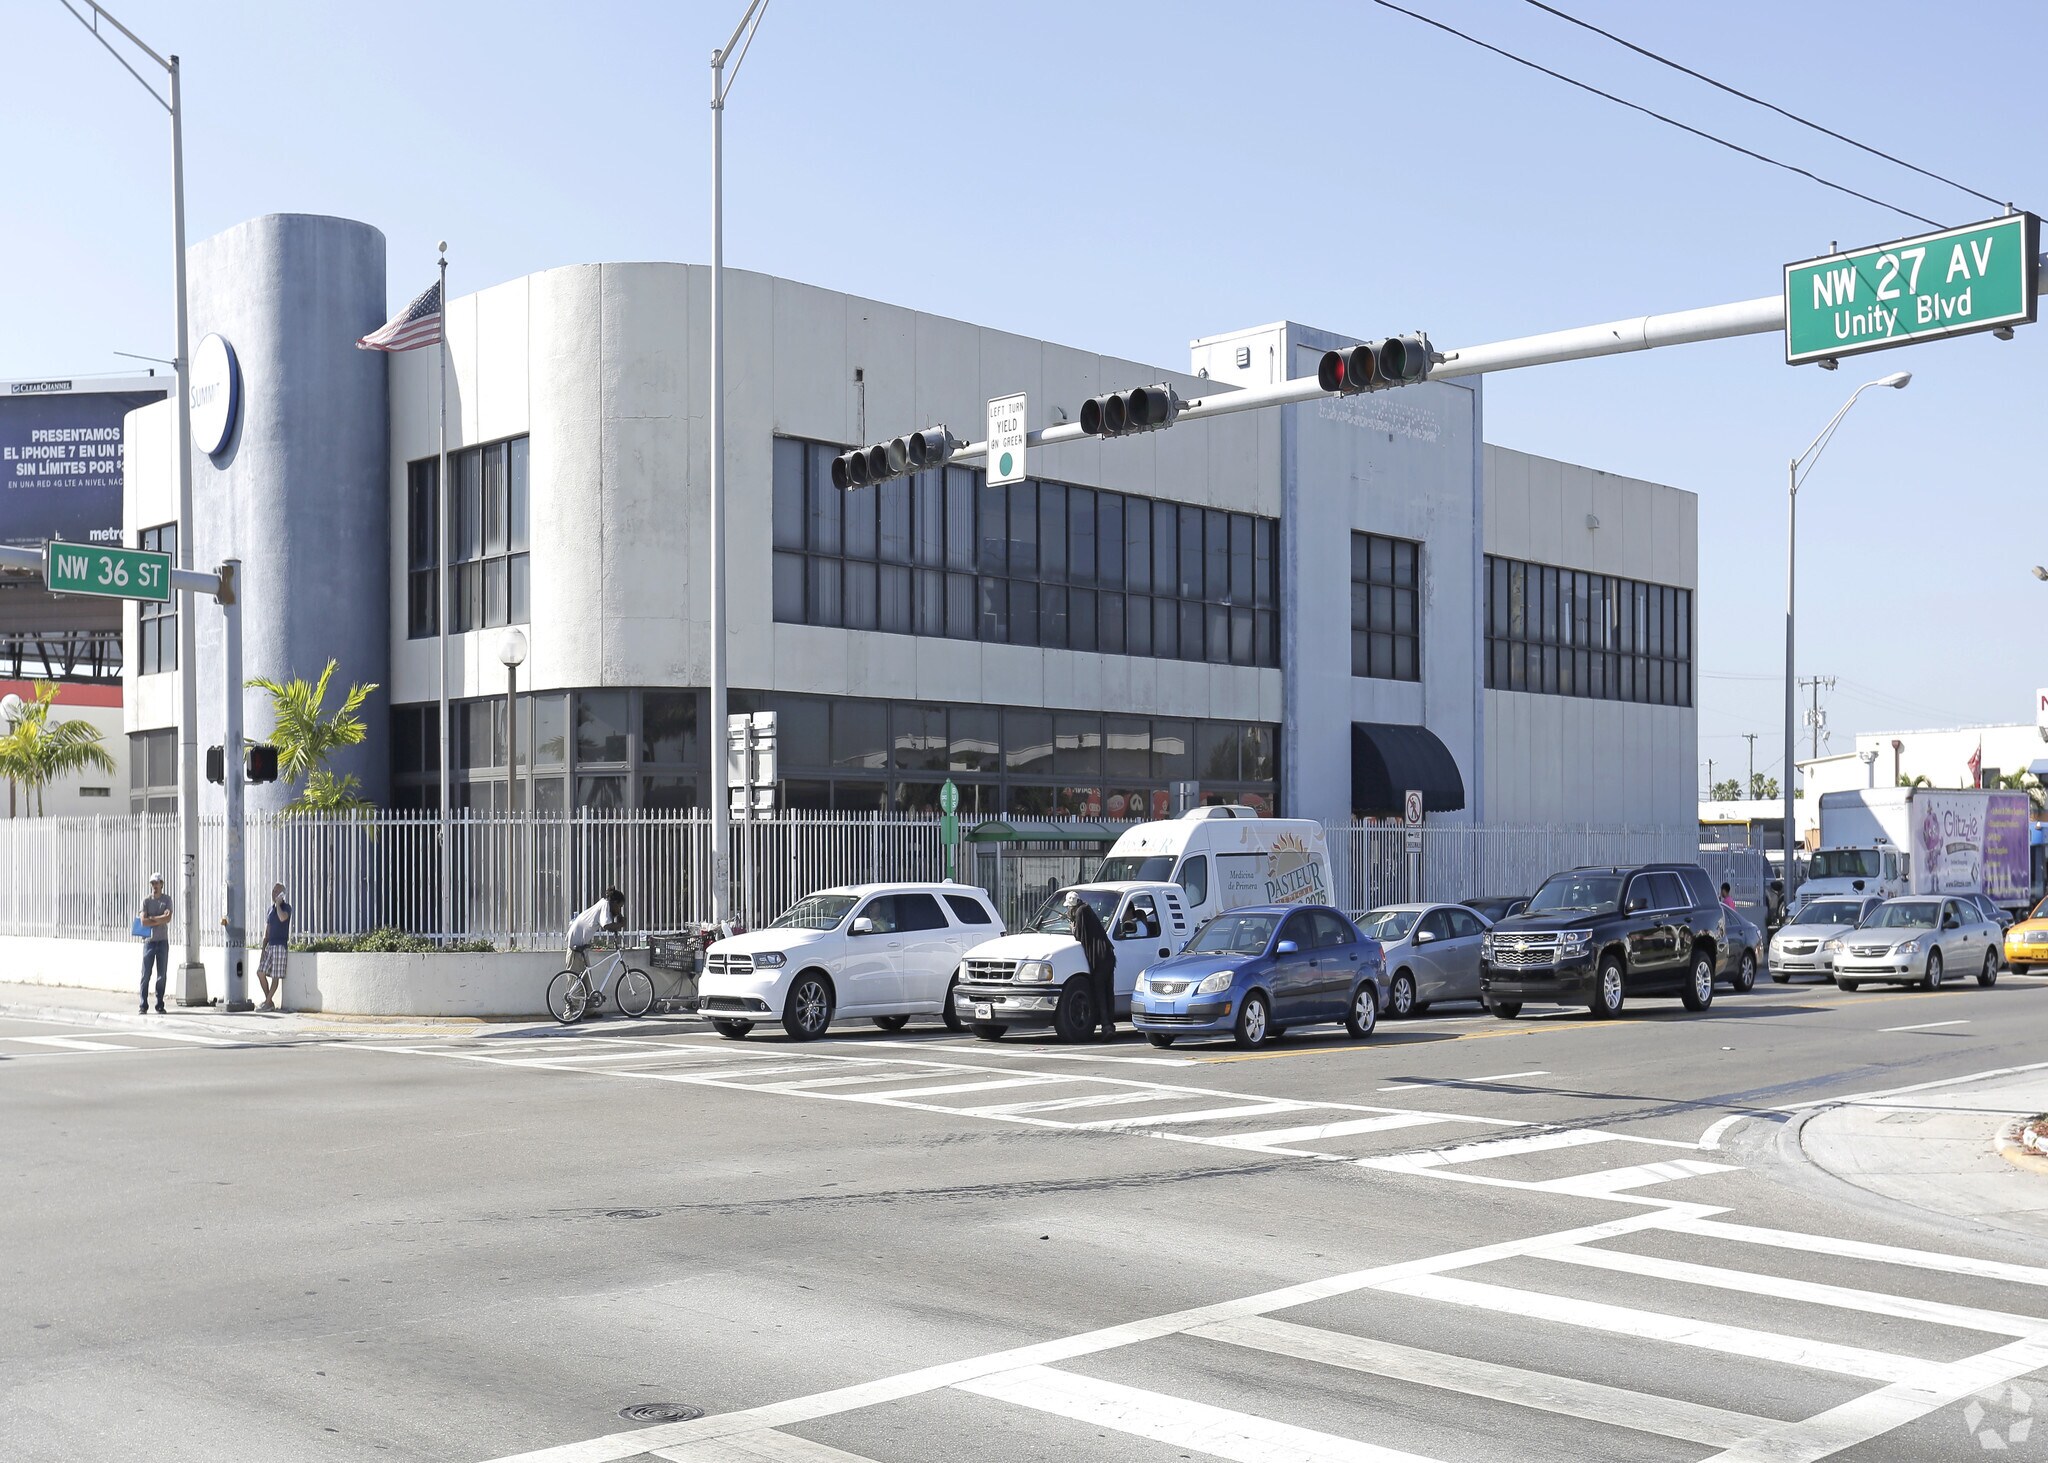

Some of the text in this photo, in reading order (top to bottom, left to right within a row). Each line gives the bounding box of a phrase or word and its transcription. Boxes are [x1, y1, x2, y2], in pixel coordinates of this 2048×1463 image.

[1813, 236, 1993, 310] NW 27 AV
[1834, 286, 1972, 339] Unity Blvd
[990, 401, 1024, 418] LEFT TURN
[996, 418, 1018, 434] YIELD
[31, 427, 120, 442] PRESENTAMOS
[1003, 434, 1023, 448] GREEN
[3, 447, 19, 460] EL
[21, 445, 66, 460] iPHONE
[68, 445, 76, 458] 7
[79, 444, 95, 458] EN
[98, 444, 114, 457] UN
[16, 462, 36, 476] SIN
[39, 459, 86, 476] LÍMITES
[89, 460, 114, 474] POR
[8, 481, 17, 489] EN
[20, 480, 35, 489] UNA
[36, 480, 51, 488] RED
[64, 479, 76, 488] LTE
[78, 479, 84, 487] A
[85, 478, 106, 487] NIVEL
[57, 554, 162, 587] NW 36 ST
[1944, 810, 1978, 841] Glitzzie
[1229, 870, 1254, 879] Medicina
[1264, 861, 1325, 904] PASTEUR
[1228, 881, 1258, 890] de Primera
